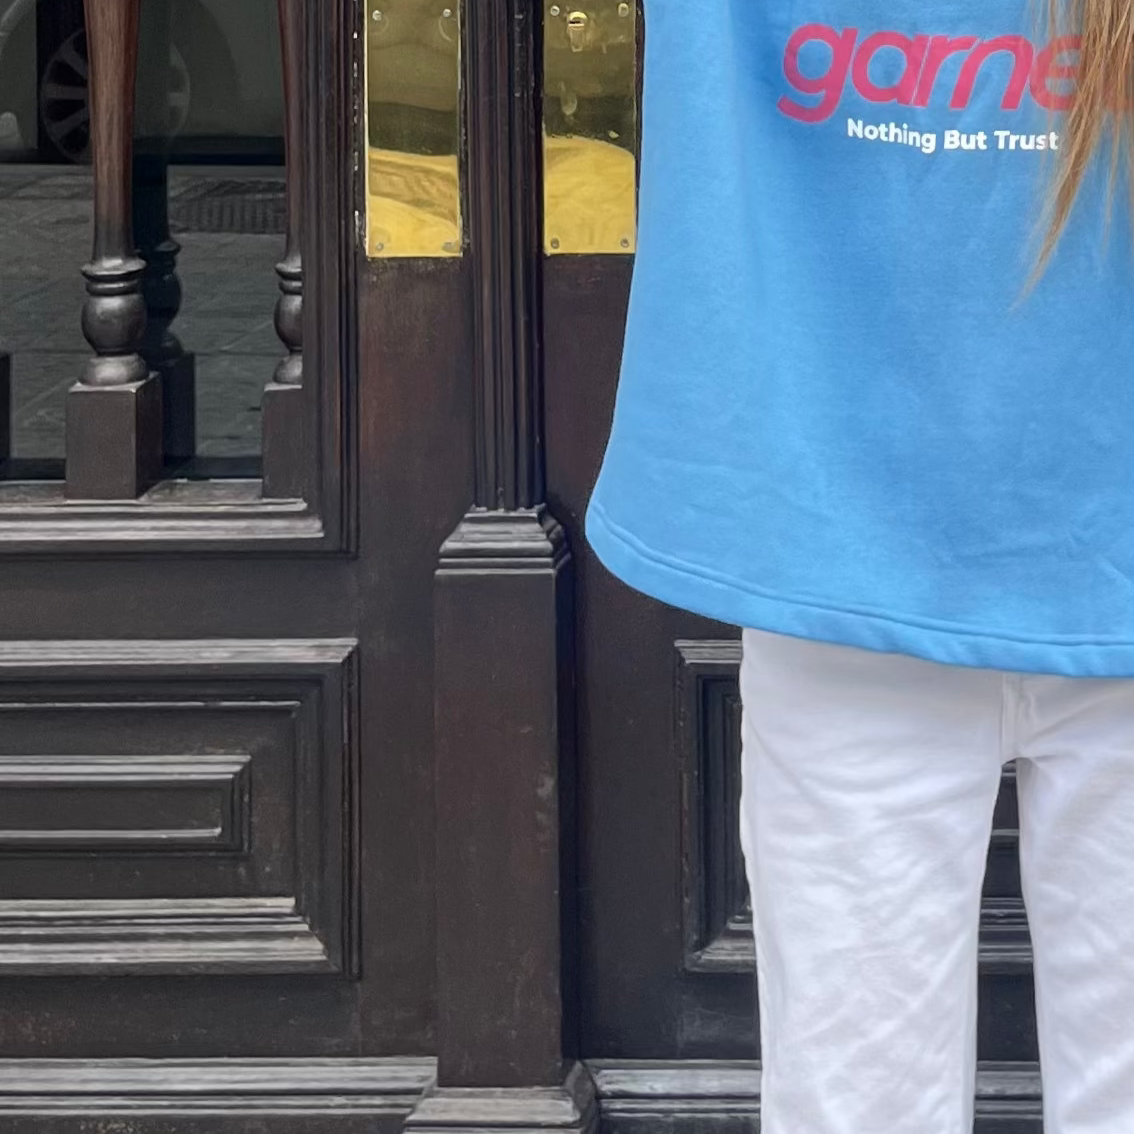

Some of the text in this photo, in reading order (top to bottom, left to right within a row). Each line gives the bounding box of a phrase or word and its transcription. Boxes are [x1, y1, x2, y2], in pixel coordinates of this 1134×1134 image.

[846, 117, 1059, 154] Nothing But Trust
